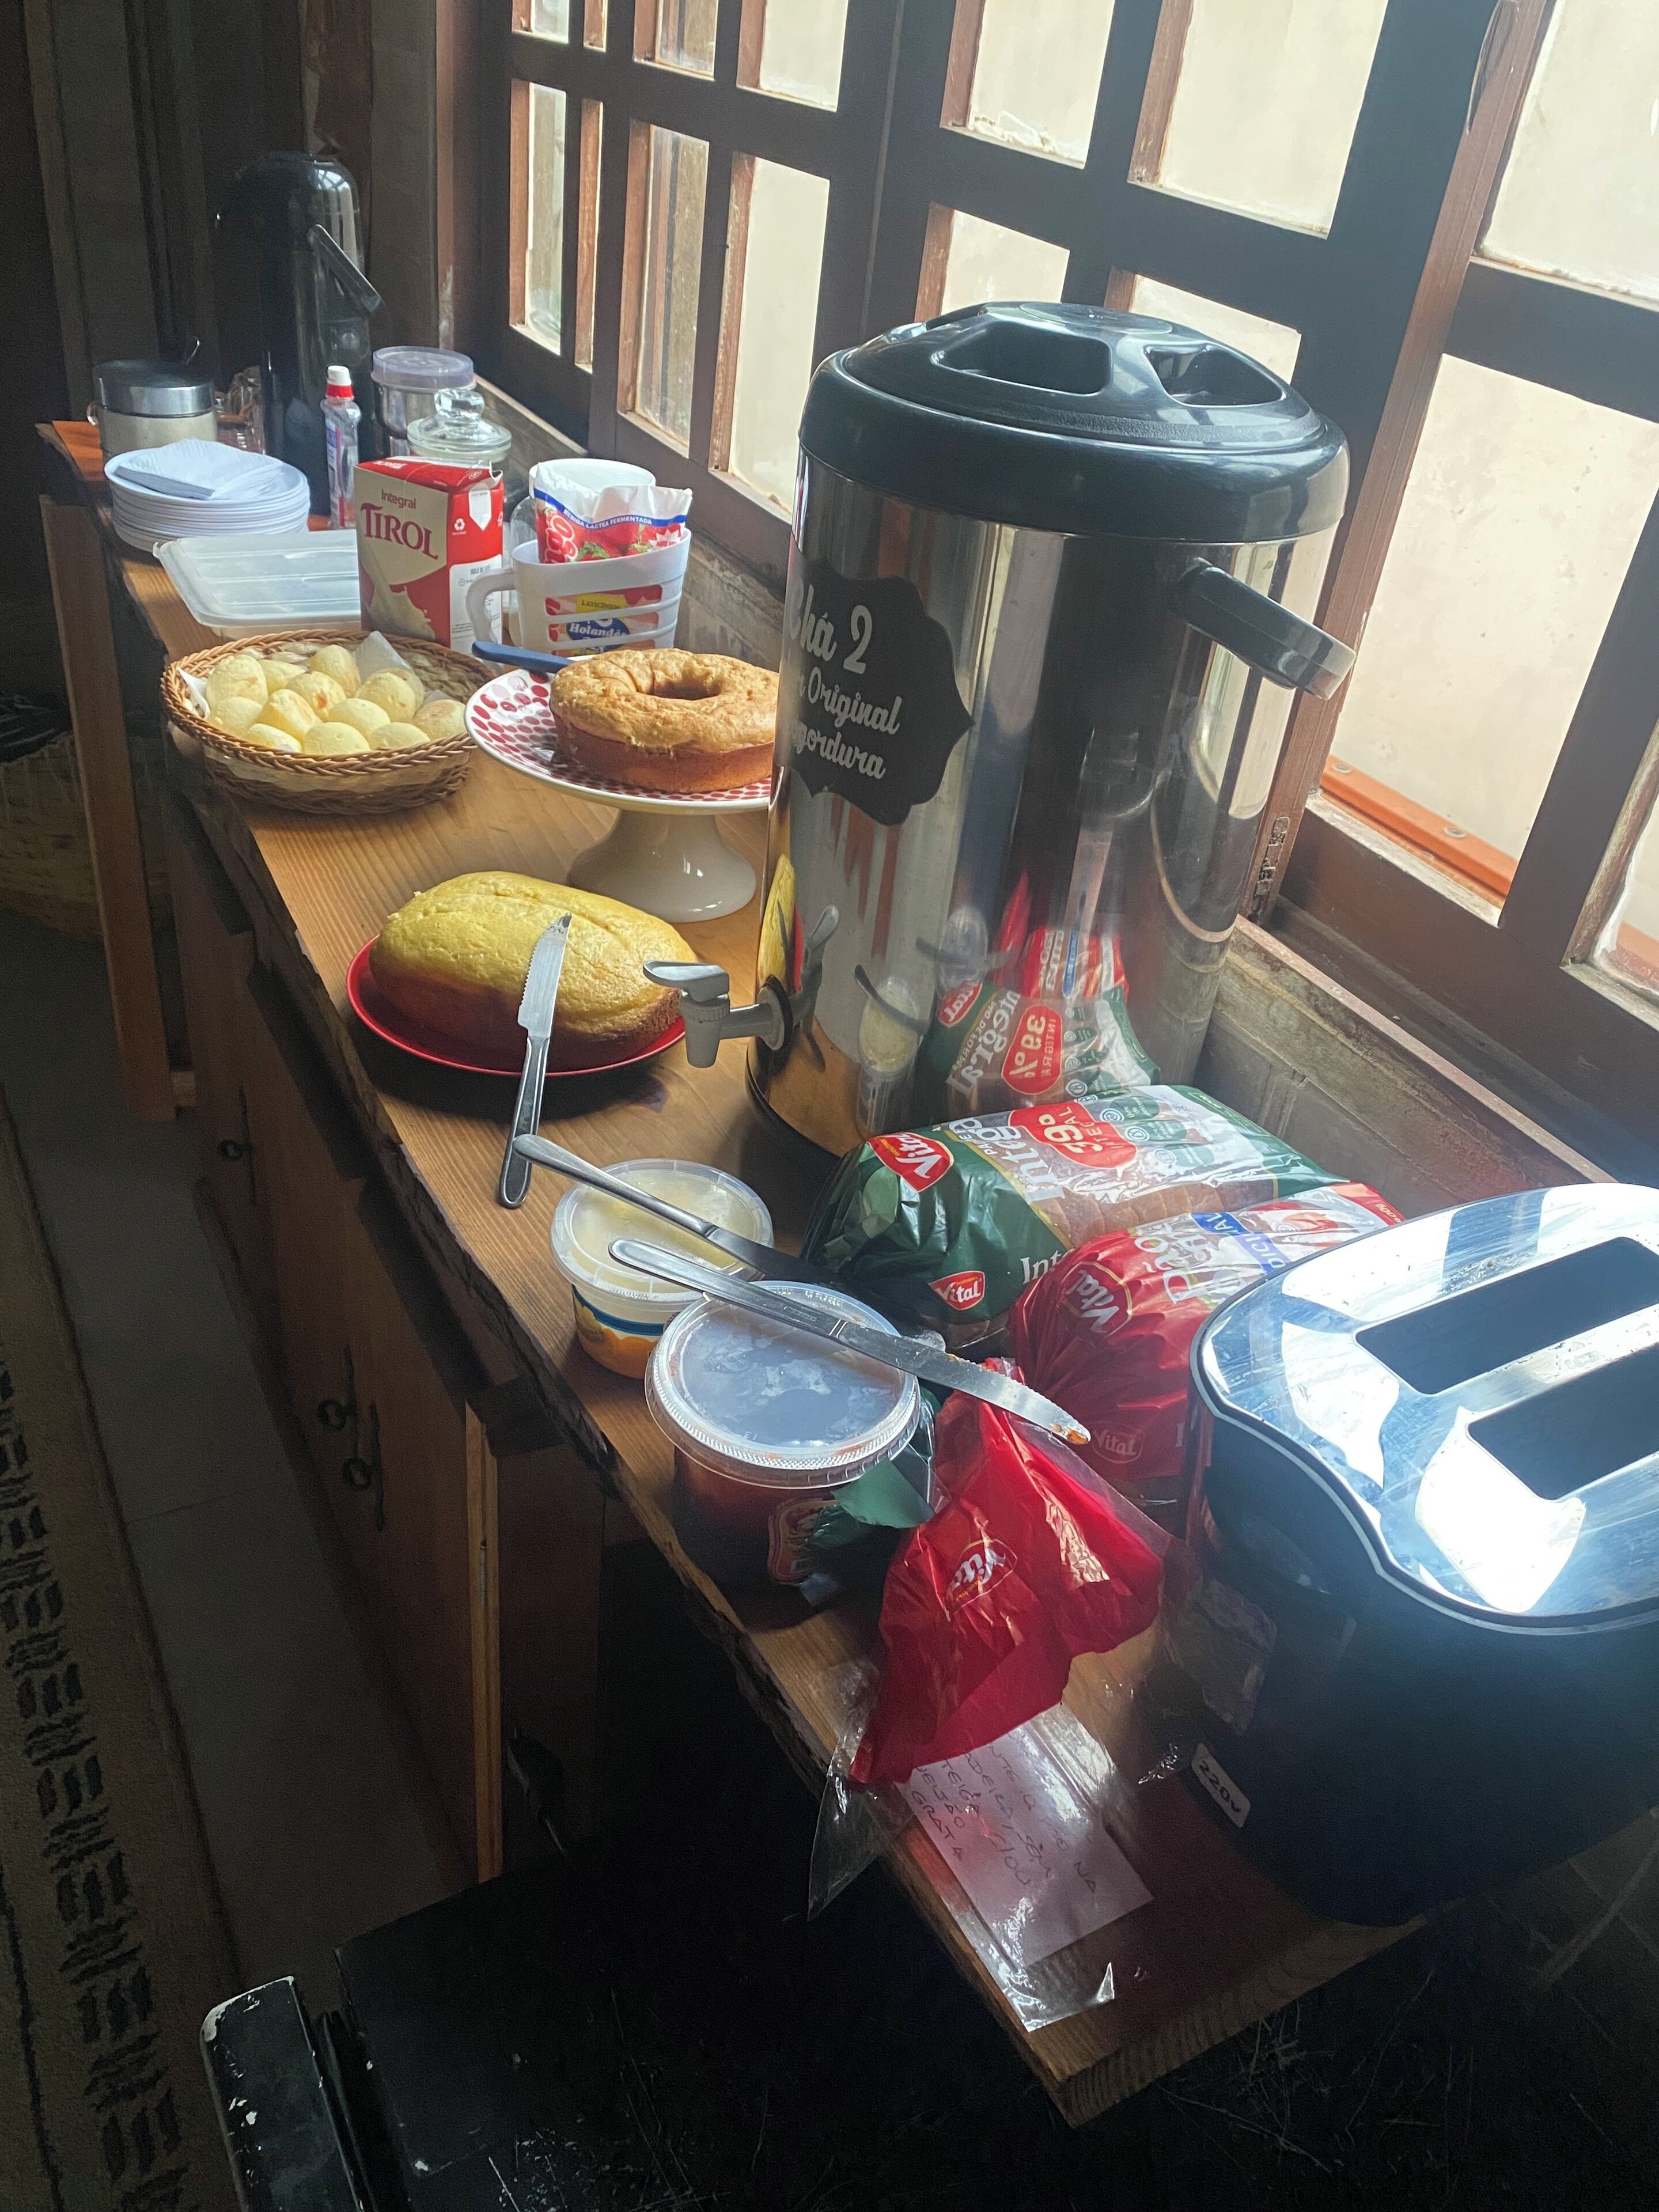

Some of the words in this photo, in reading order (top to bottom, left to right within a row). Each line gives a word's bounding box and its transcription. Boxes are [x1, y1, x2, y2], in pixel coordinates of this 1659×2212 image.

[381, 489, 416, 509] Integral
[563, 509, 585, 527] BEBIDA
[610, 516, 652, 526] FERMENTADA
[360, 502, 439, 560] TIROL
[789, 578, 837, 661] Chá
[843, 604, 872, 675] 2
[808, 666, 903, 735] Original
[935, 1279, 982, 1303] Vital
[1065, 1270, 1119, 1334] Vital
[1094, 1429, 1137, 1456] Vital
